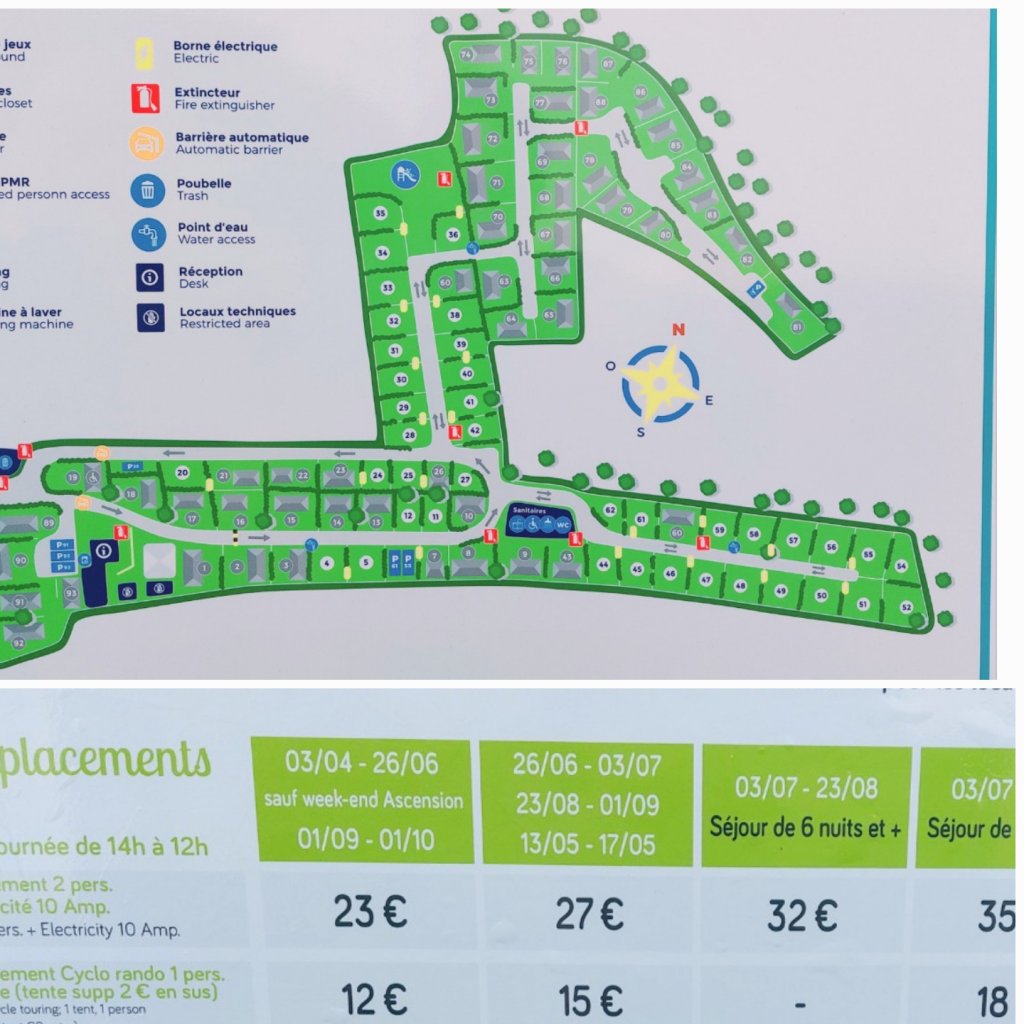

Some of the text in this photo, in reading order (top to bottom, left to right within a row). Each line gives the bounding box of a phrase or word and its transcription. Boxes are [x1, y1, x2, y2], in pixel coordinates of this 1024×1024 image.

[3, 39, 30, 51] jeux
[174, 41, 277, 53] Borne électrique
[174, 53, 218, 63] Electric
[175, 88, 240, 97] Extincteur
[176, 100, 275, 112] Fire extinguisher
[176, 132, 309, 146] Barrière automatique
[176, 145, 283, 154] Automatic barrier
[1, 177, 29, 186] PMR
[178, 179, 231, 188] Poubelle
[18, 192, 67, 201] personn
[177, 191, 208, 200] Trash
[376, 210, 385, 218] 35
[179, 222, 247, 232] Point d'eau
[178, 235, 213, 244] Water
[449, 231, 458, 239] 36
[180, 266, 242, 281] Réception
[179, 277, 210, 288] Desk
[383, 284, 392, 292] 33
[21, 307, 27, 317] à
[32, 307, 61, 316] laver
[180, 306, 296, 320] Locaux techniques
[20, 319, 73, 329] machine
[180, 318, 271, 329] Restricted area
[673, 323, 685, 336] N
[606, 361, 616, 371] O
[462, 370, 472, 378] 40
[397, 376, 407, 384] 30
[706, 395, 713, 405] E
[470, 427, 479, 435] 42
[637, 427, 645, 437] S
[177, 469, 188, 477] 20
[373, 472, 382, 480] 24
[460, 476, 470, 484] 27
[513, 506, 546, 515] Sanitaires
[556, 520, 570, 529] WC
[789, 537, 798, 545] 57
[736, 582, 745, 590] 48
[859, 601, 866, 609] 51
[512, 751, 579, 777] 26/06
[598, 752, 662, 778] 03/07
[263, 789, 464, 810] sauf week-end Ascension
[710, 815, 901, 841] Séjour de 6 nuits et +
[76, 835, 101, 855] de
[107, 836, 145, 855] 14h
[152, 836, 164, 856] à
[170, 836, 208, 856] 12h
[54, 877, 65, 891] 2
[71, 880, 113, 896] pers.
[335, 894, 407, 928] 23 €
[64, 1004, 69, 1013] 1
[100, 1004, 104, 1013] 1
[106, 1006, 147, 1016] person
